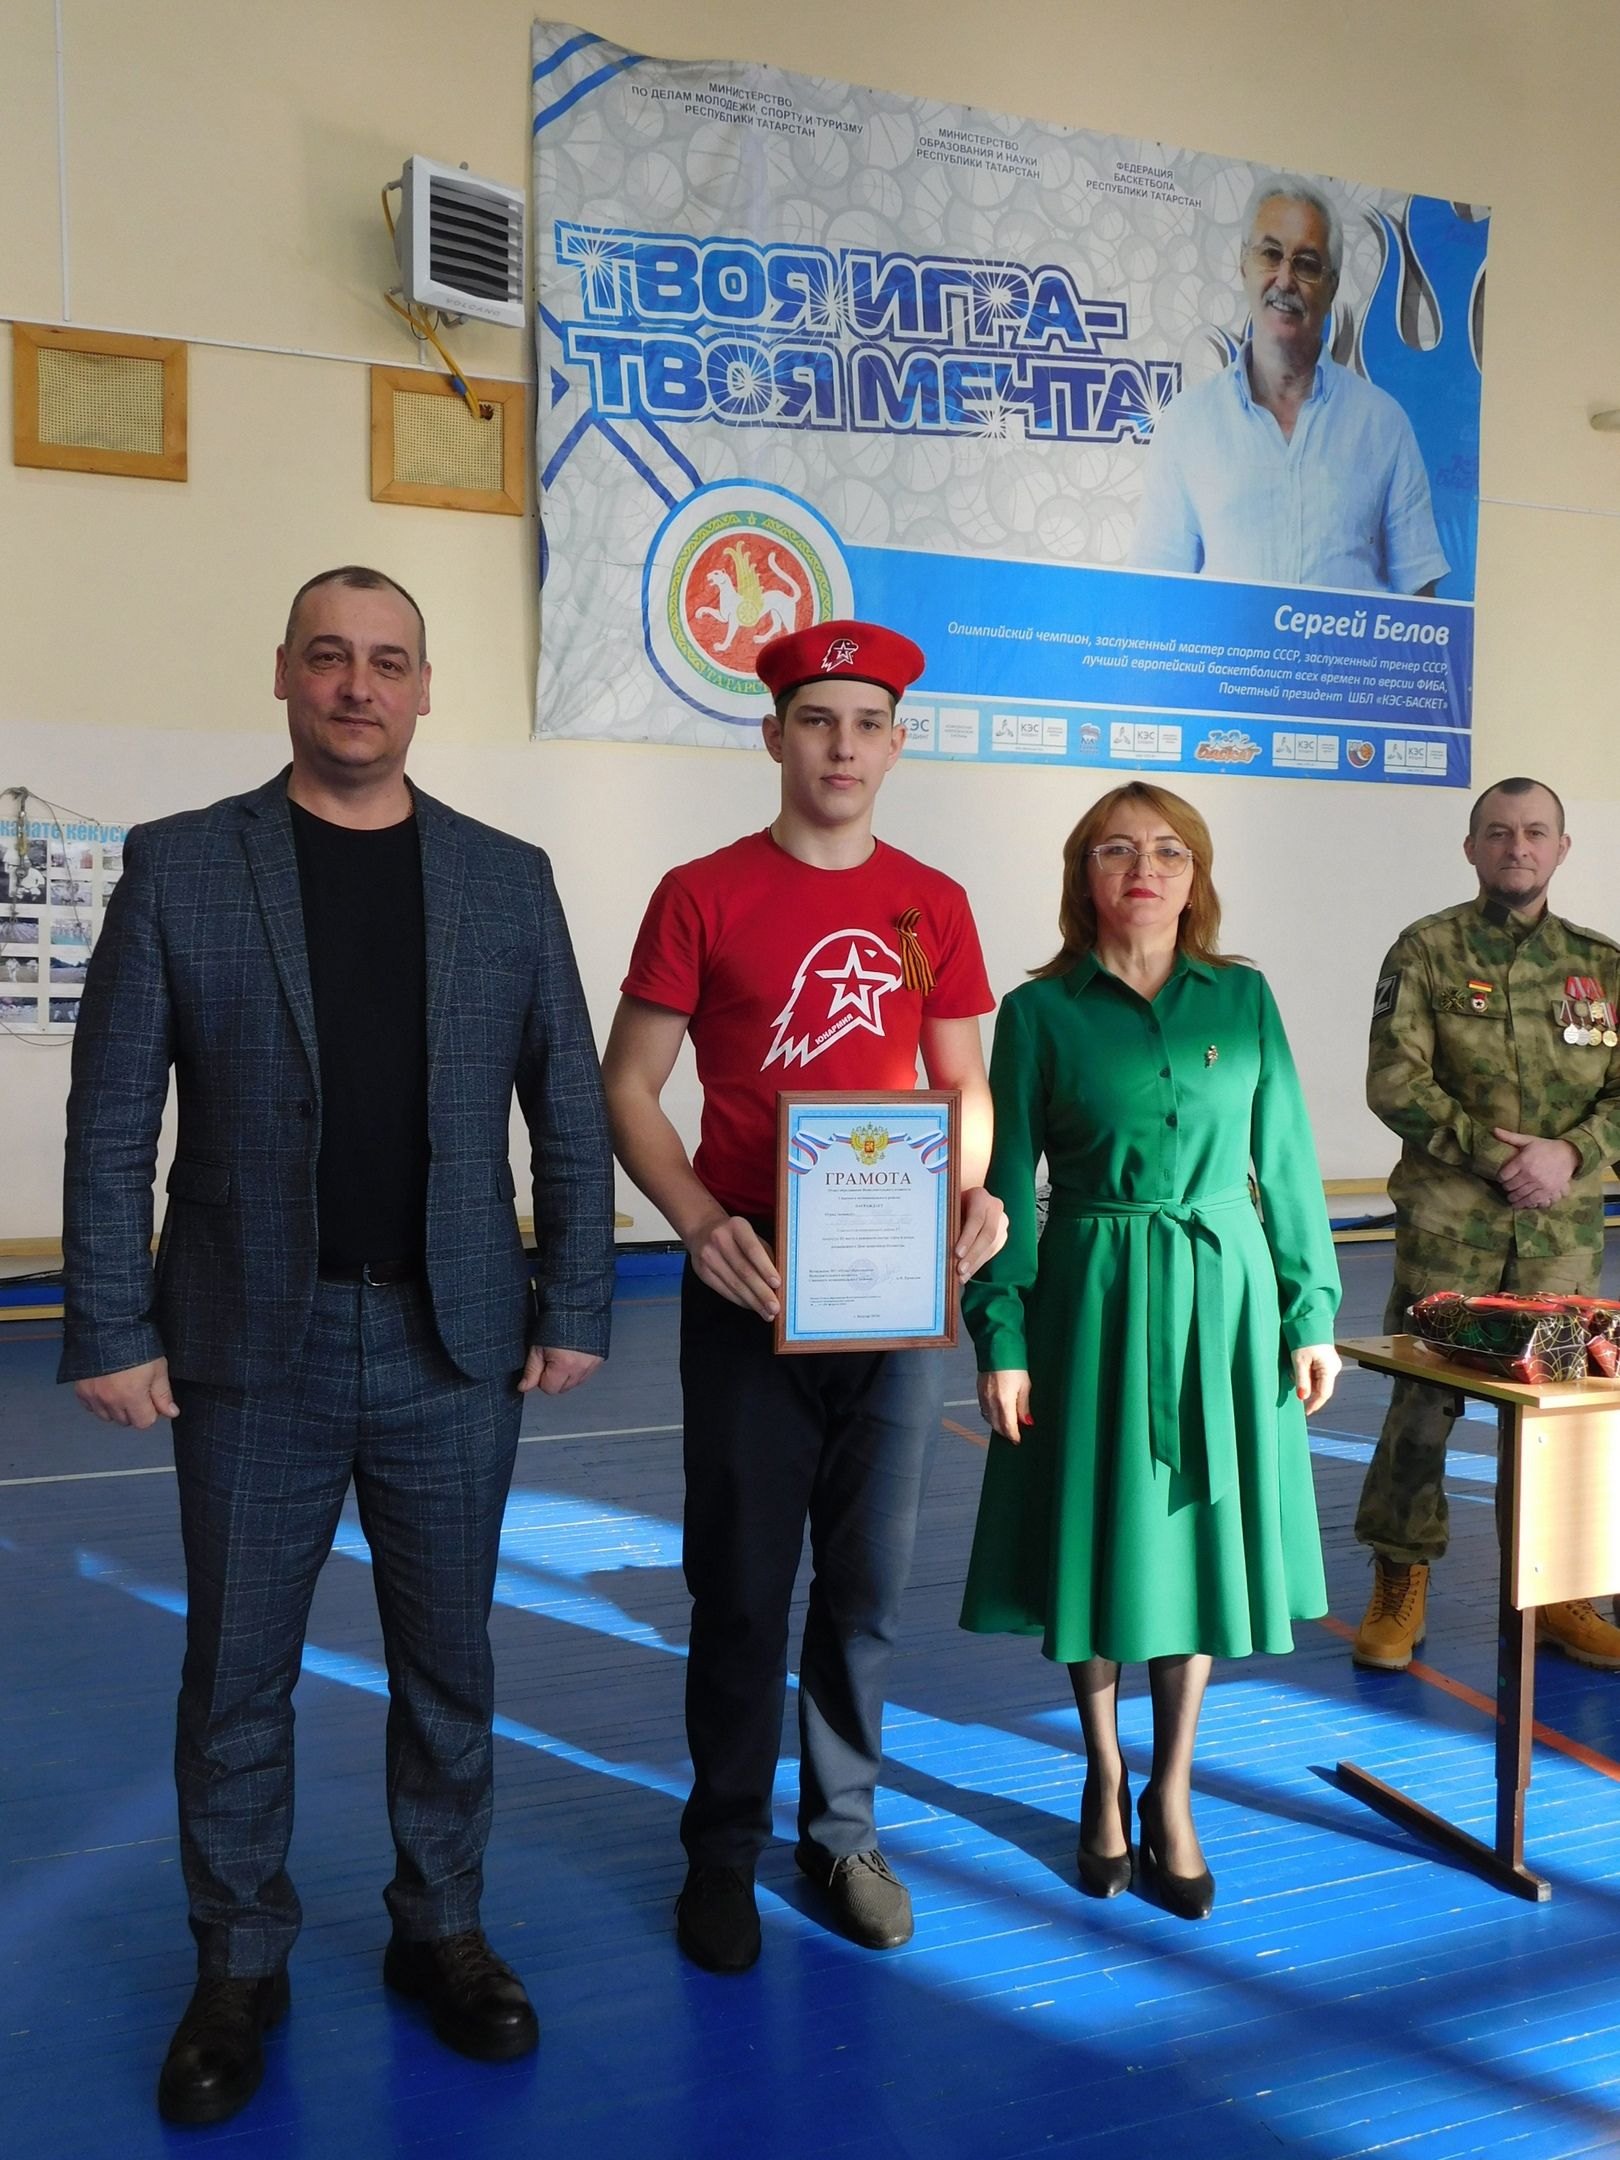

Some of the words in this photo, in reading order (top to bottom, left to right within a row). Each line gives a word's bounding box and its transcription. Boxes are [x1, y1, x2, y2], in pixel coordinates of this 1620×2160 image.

[631, 86, 648, 97] ПО
[651, 88, 692, 100] ДЕЛАМ
[761, 106, 802, 122] СПОРТУ
[805, 115, 813, 125] И
[816, 117, 863, 134] ТУРИЗМУ
[709, 82, 792, 107] МИНИСТЕРСТВО
[685, 105, 753, 125] РЕСПУБЛИКИ
[757, 118, 815, 137] ТАТАРСТАН
[919, 137, 993, 158] ОБРАЗОВАНИЯ
[996, 151, 1003, 160] И
[1006, 153, 1038, 166] НАУКИ
[938, 128, 1019, 151] МИНИСТЕРСТВО
[916, 148, 982, 168] РЕСПУБЛИКИ
[985, 161, 1040, 179] ТАТАРСТАН
[1116, 162, 1173, 179] ФЕДЕРАЦИЯ
[1086, 180, 1148, 198] РЕСПУБЛИКИ
[1150, 191, 1202, 208] ТАТАРСТАН
[1114, 173, 1175, 191] БАСКЕТБОЛА
[554, 220, 841, 338] ТВОЯ
[561, 321, 848, 431] ТВОЯ
[1274, 604, 1367, 639] Сергей
[1373, 614, 1450, 645] Белов
[947, 621, 1034, 640] Олимпийский
[1036, 632, 1092, 647] чемпион,
[1095, 635, 1176, 651] заслуженный
[1178, 643, 1225, 658] мастер
[1227, 647, 1270, 660] спорта
[1273, 648, 1302, 663] СССР,
[1304, 654, 1378, 668] заслуженный
[1379, 660, 1420, 673] тренер
[1422, 661, 1449, 676] СССР,
[1082, 654, 1128, 667] лучший
[1131, 657, 1205, 673] европейский
[1208, 662, 1292, 679] баскетболист
[1294, 671, 1318, 681] всех
[1320, 672, 1361, 685] времен
[1363, 677, 1376, 686] по
[1378, 678, 1415, 690] версии
[1416, 679, 1448, 693] ФИБА,
[1219, 681, 1279, 697] Почетный
[1282, 688, 1343, 702] президент
[1348, 692, 1373, 704] ШБЛ
[1376, 694, 1448, 709] «КЭС-БАСКЕТ»
[815, 1013, 853, 1044] ЮНАРМИЯ
[825, 1172, 912, 1185] ГРАМОТА
